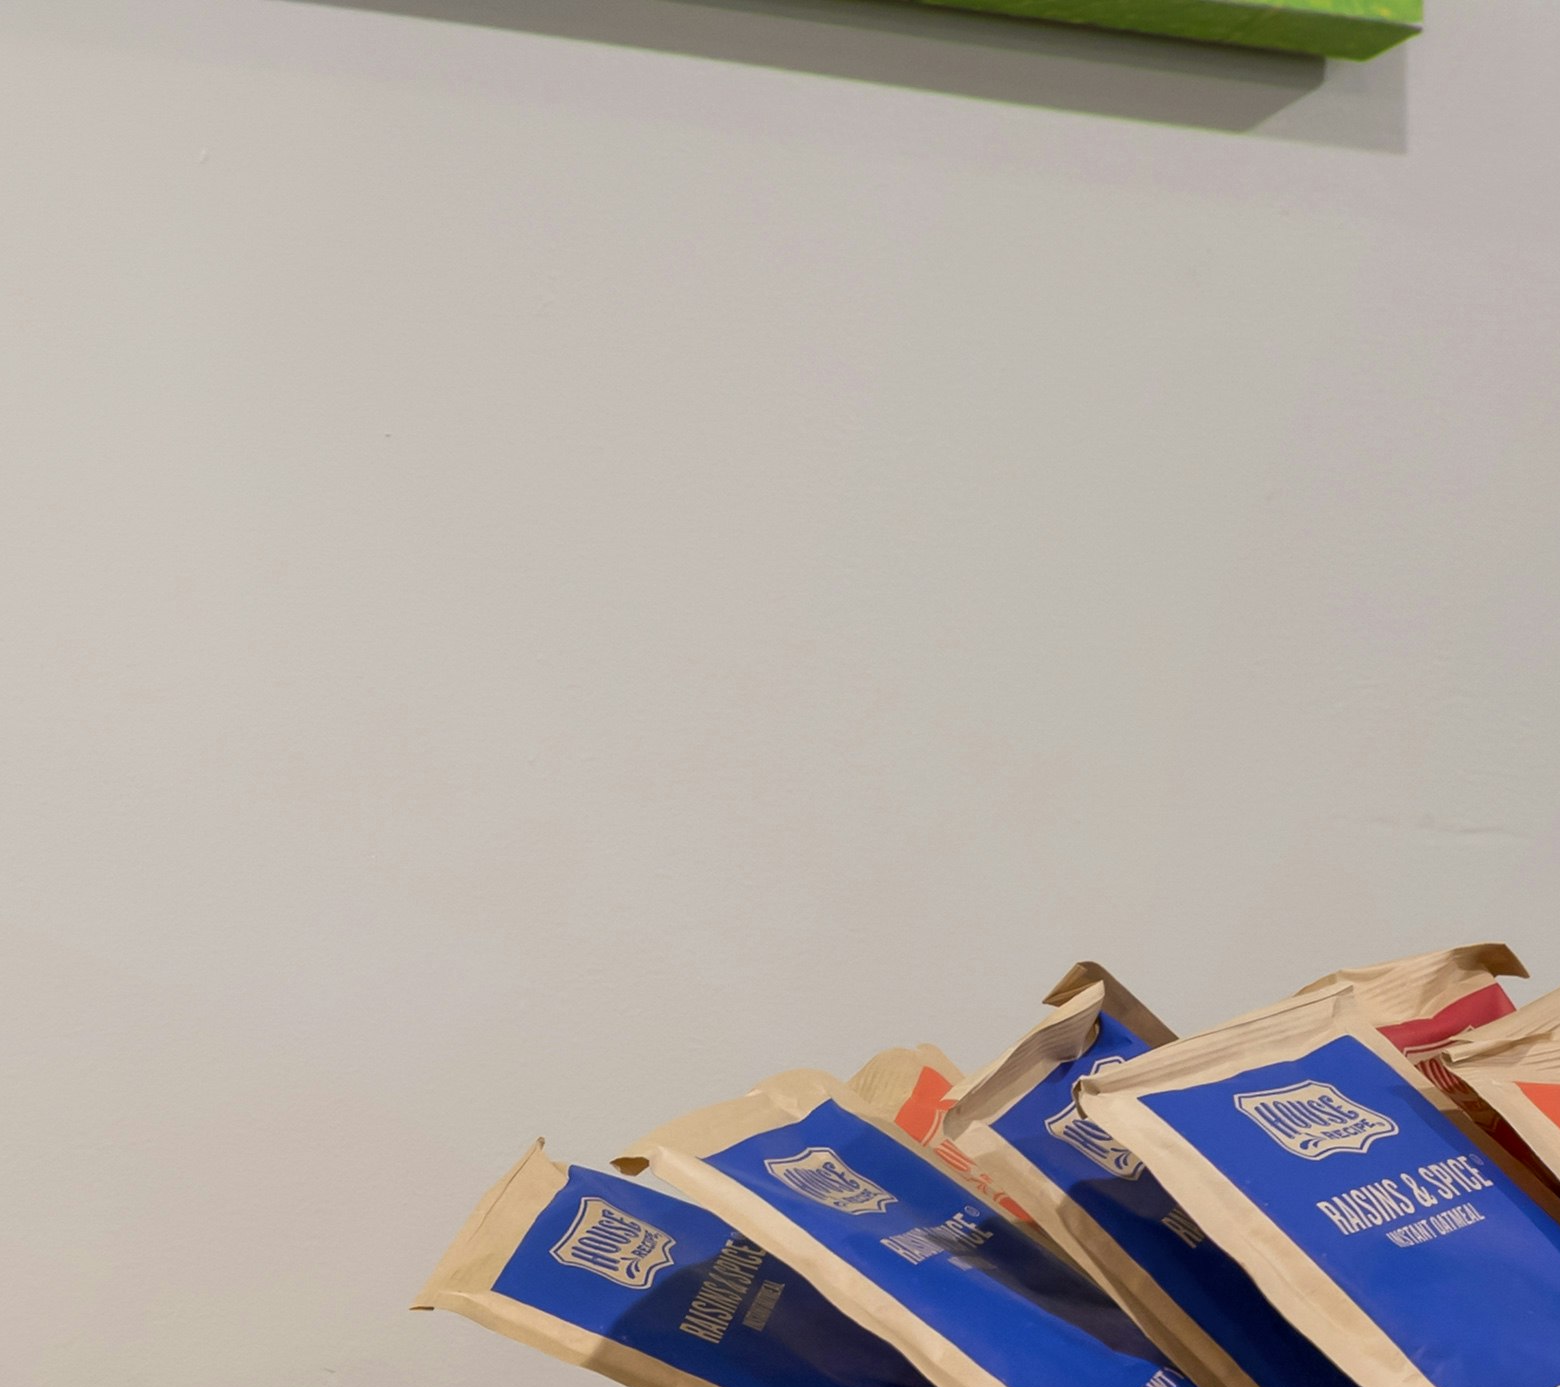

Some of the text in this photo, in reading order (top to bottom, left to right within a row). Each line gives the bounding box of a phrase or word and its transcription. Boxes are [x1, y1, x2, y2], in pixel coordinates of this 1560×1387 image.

[1254, 1095, 1360, 1139] HOUSE
[1323, 1118, 1375, 1141] RECIPE
[1316, 1155, 1494, 1236] RAISINS & SPICE
[571, 1209, 642, 1272] HOUSE
[1386, 1202, 1485, 1248] INSTANT OATMEAL
[678, 1279, 742, 1344] RAISINS
[712, 1238, 767, 1286] SPICE
